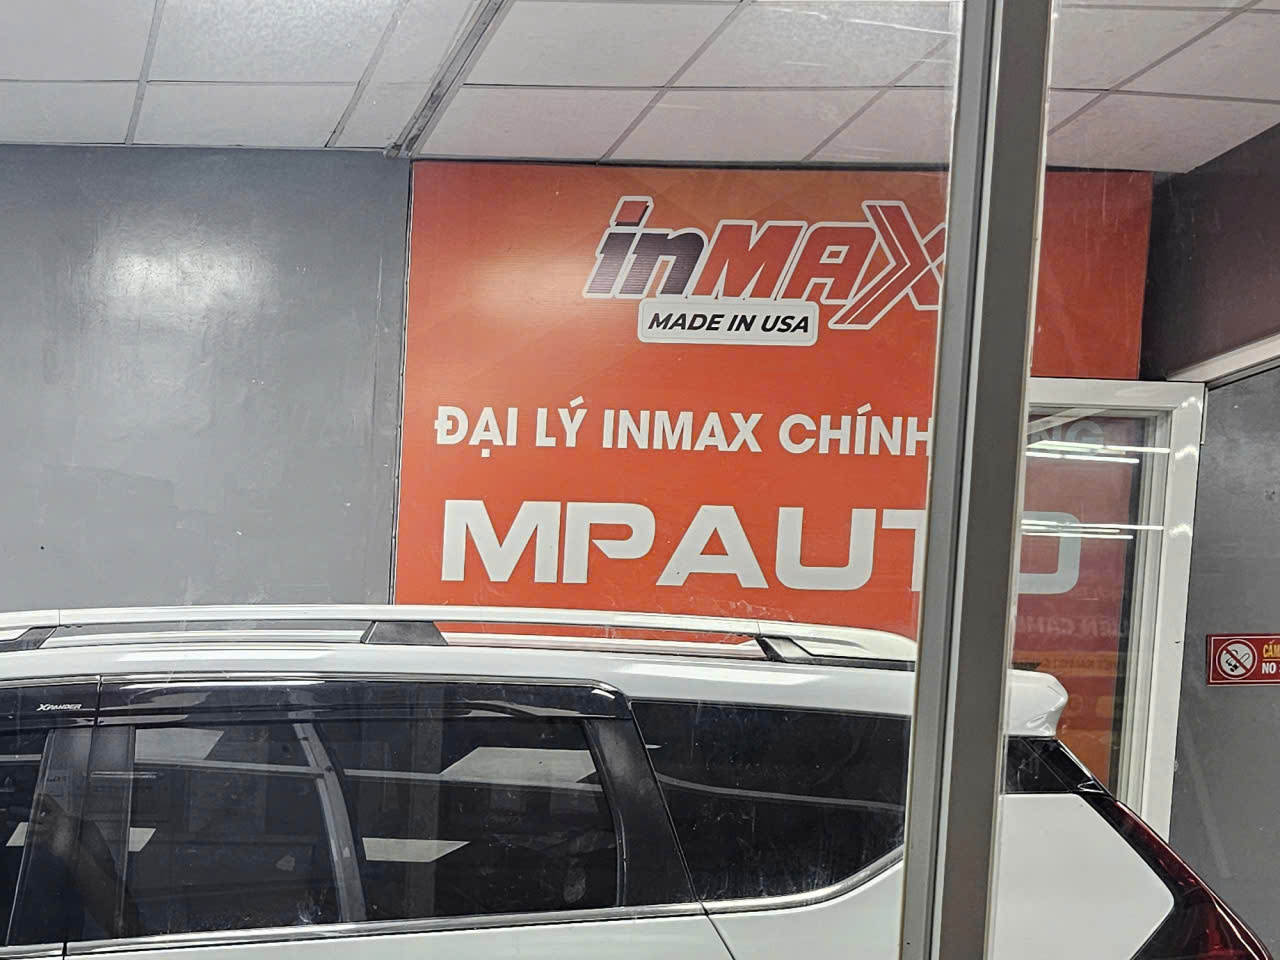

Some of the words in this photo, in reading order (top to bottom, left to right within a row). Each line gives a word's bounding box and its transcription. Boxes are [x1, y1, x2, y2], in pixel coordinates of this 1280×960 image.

[583, 196, 946, 330] inMAX
[648, 312, 722, 333] MADE
[727, 313, 756, 333] IN
[760, 314, 810, 334] USA
[434, 405, 518, 458] ĐẠI
[536, 396, 587, 448] LÝ
[602, 409, 763, 453] INMAX
[778, 403, 934, 457] CHÍNH
[1262, 662, 1277, 674] NO
[36, 703, 82, 711] XPANDER
